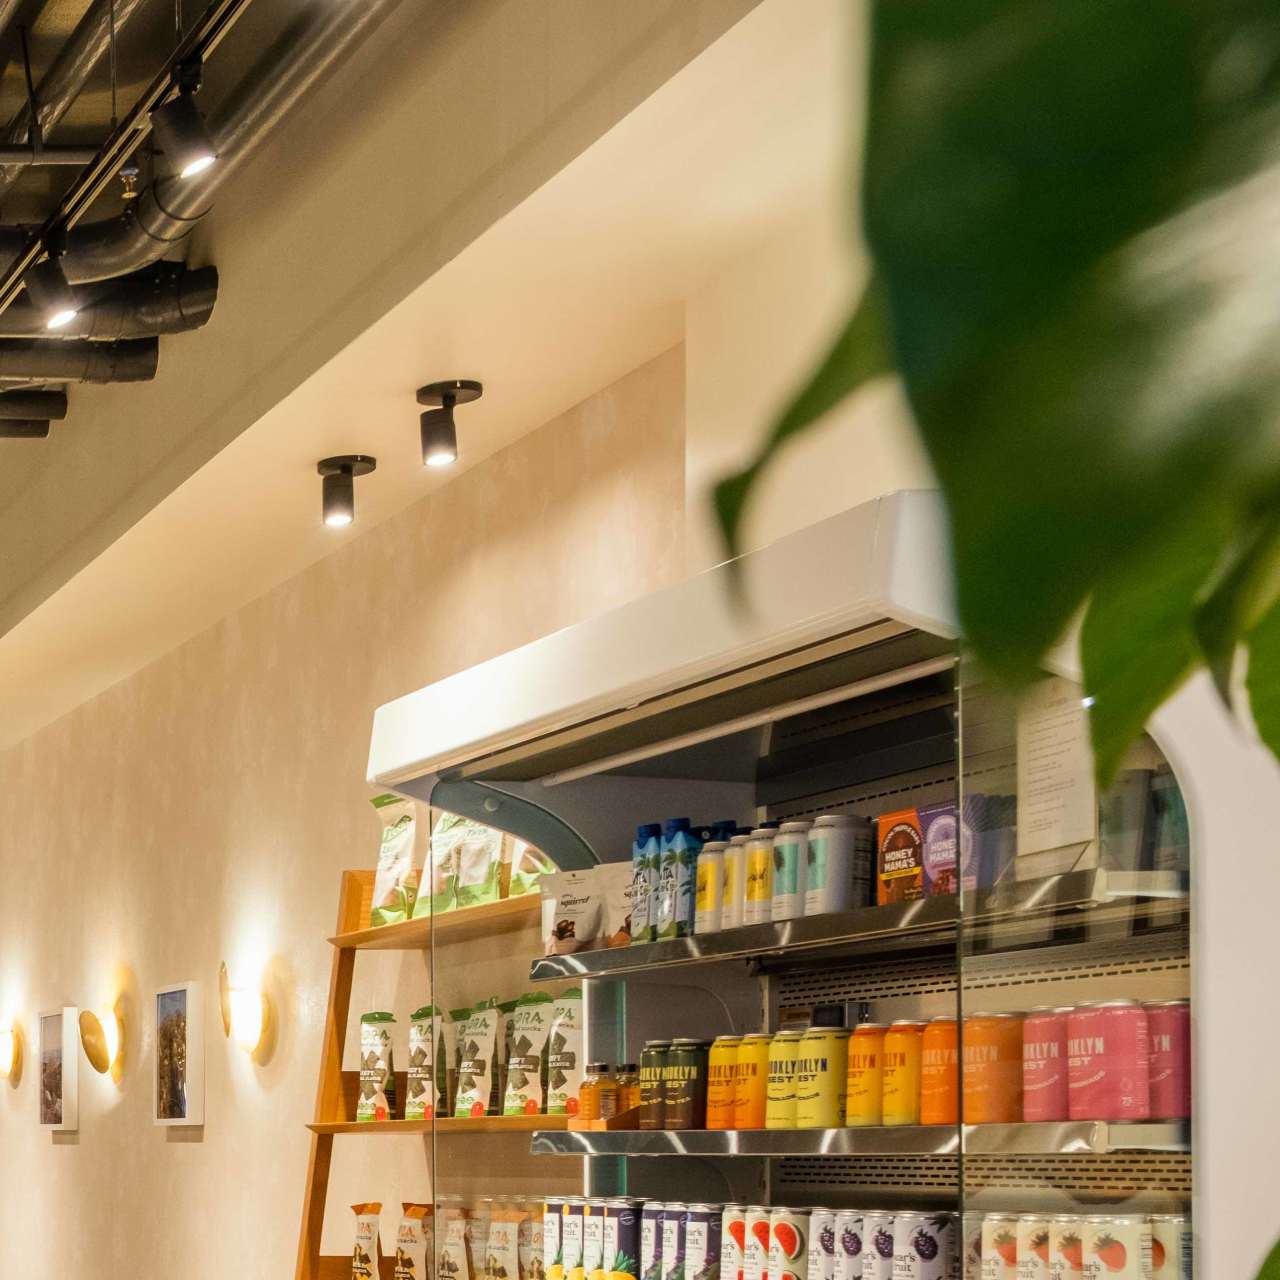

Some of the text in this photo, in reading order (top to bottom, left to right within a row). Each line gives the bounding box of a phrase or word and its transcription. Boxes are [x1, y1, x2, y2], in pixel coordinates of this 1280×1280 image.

[885, 848, 914, 861] HONEY
[884, 858, 916, 872] MAMA'S
[561, 896, 591, 908] squirrel
